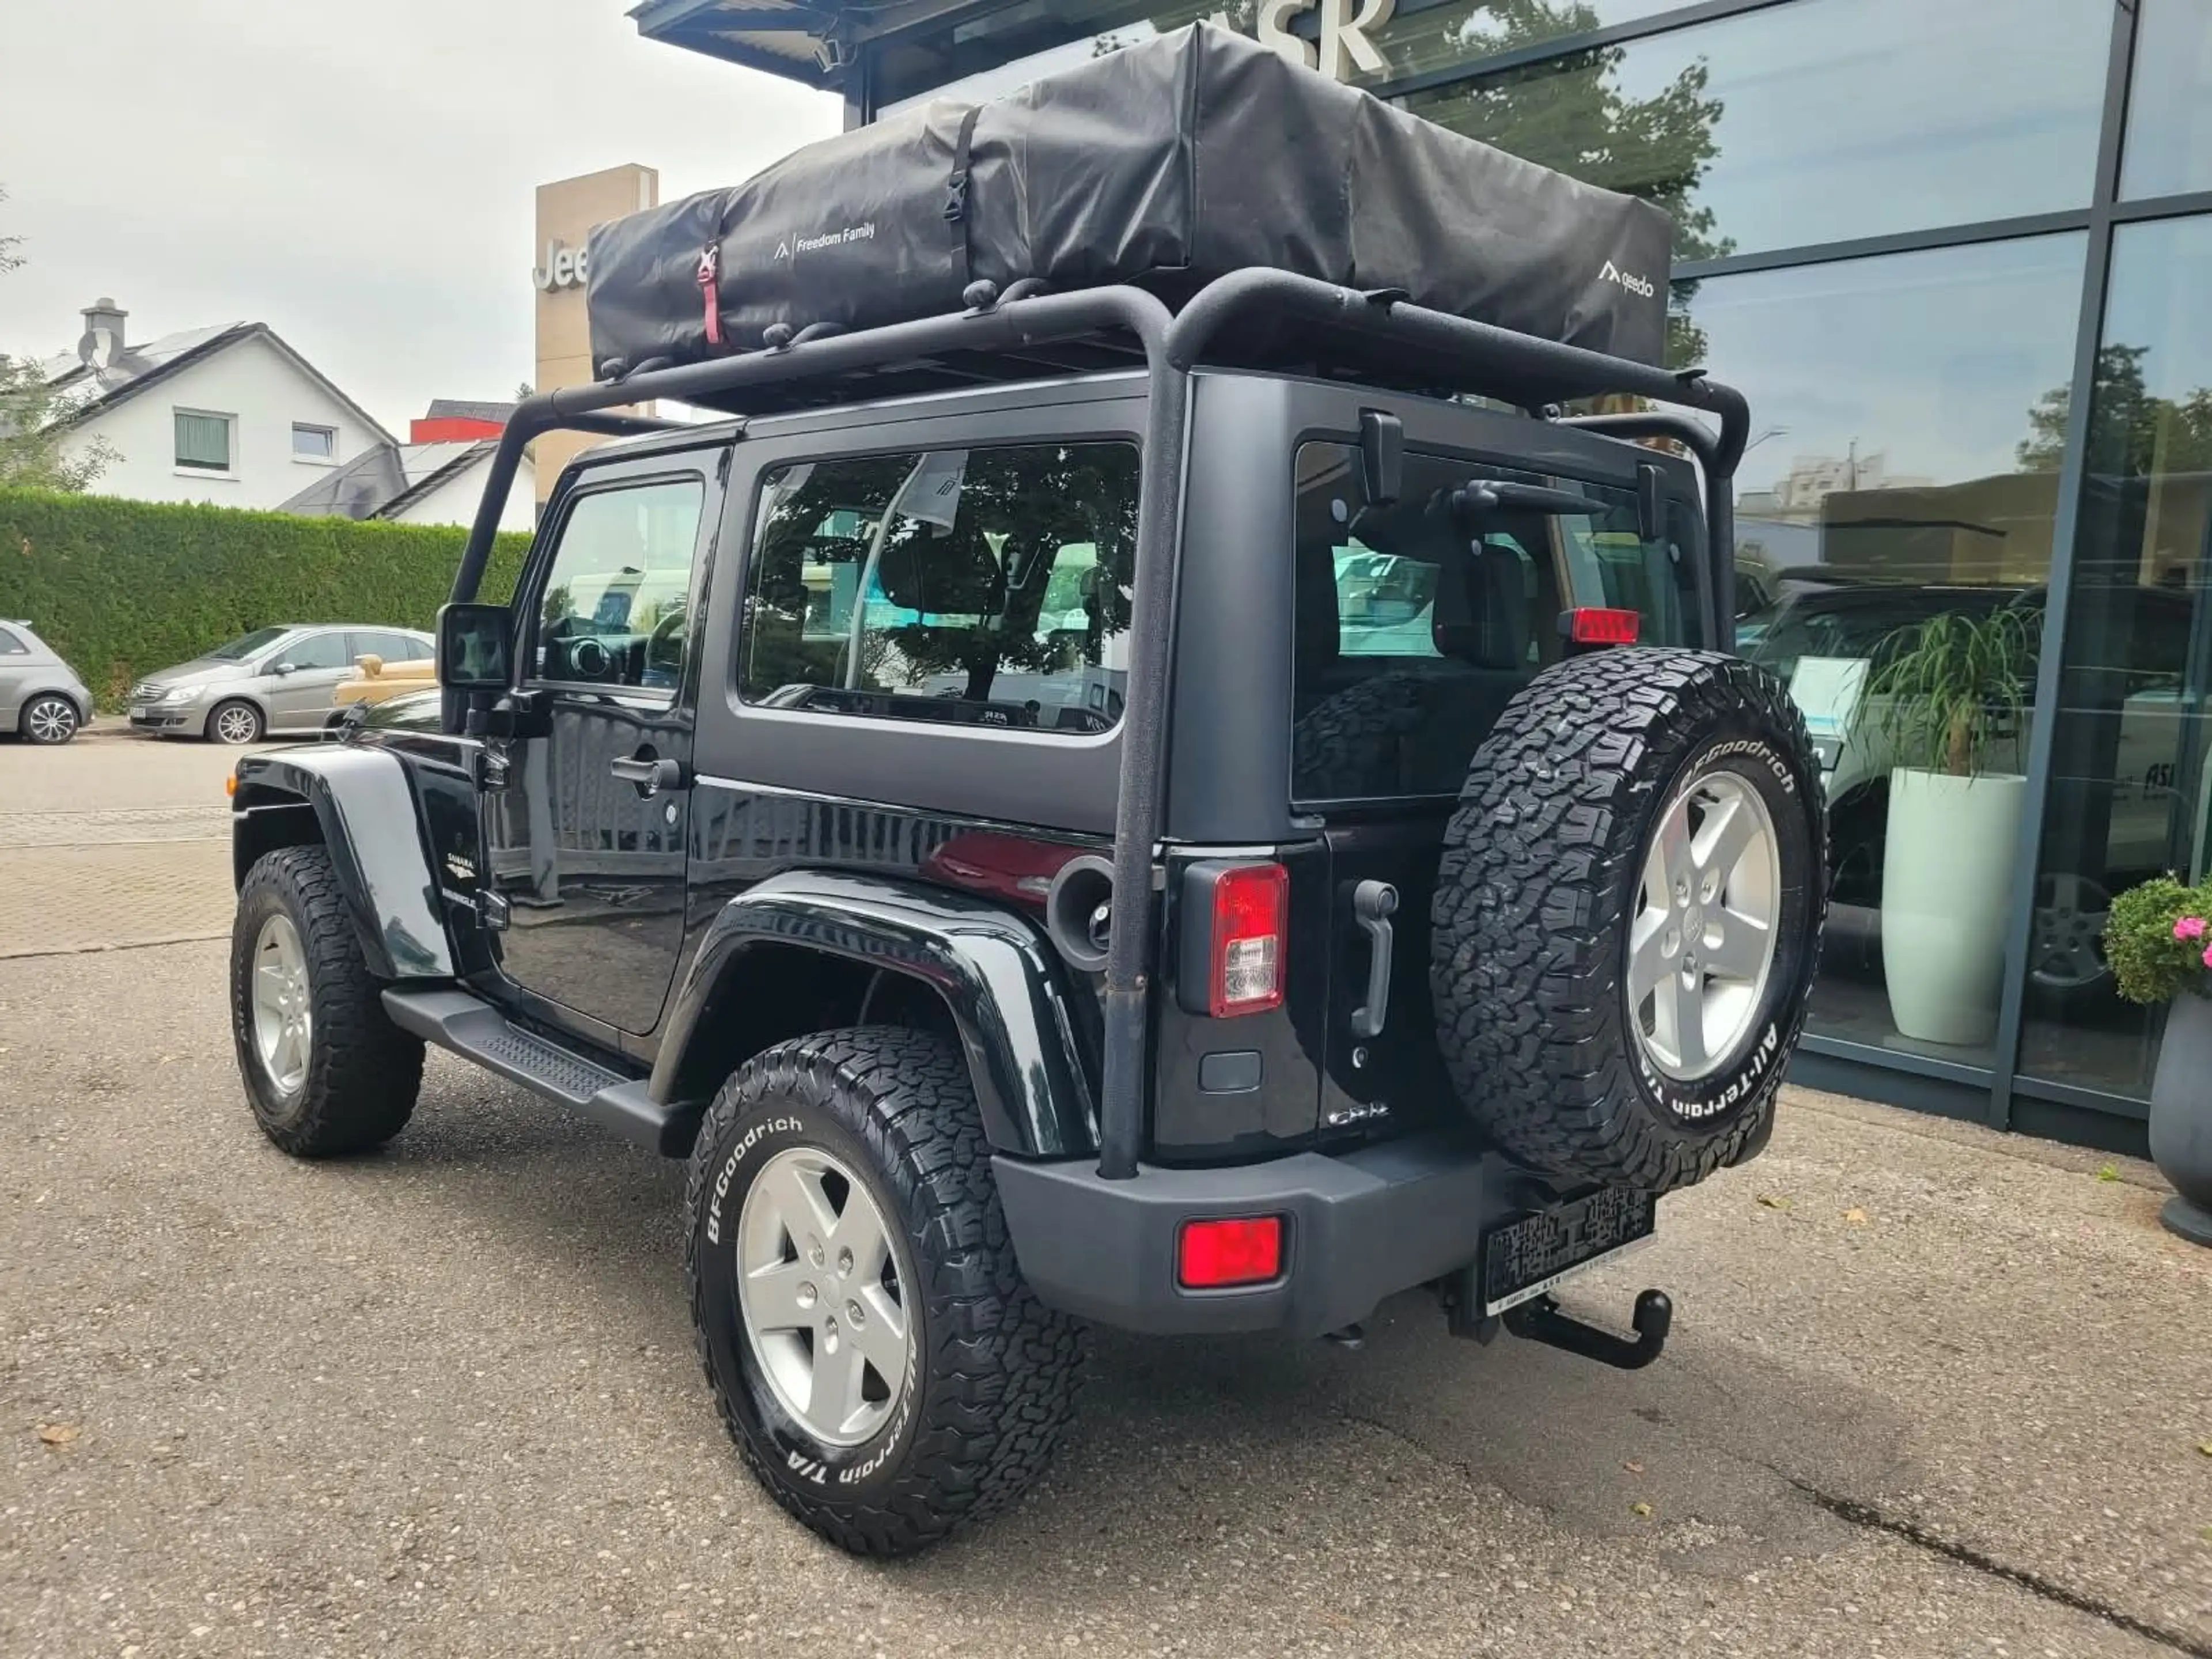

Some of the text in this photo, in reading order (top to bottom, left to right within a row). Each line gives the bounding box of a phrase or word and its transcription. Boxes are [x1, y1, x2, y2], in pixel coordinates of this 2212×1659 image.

[797, 222, 875, 252] Freedom Family
[1672, 1022, 1778, 1120] All-Terrain
[708, 1116, 803, 1245] BFGoodrich
[787, 1449, 827, 1484] T/A
